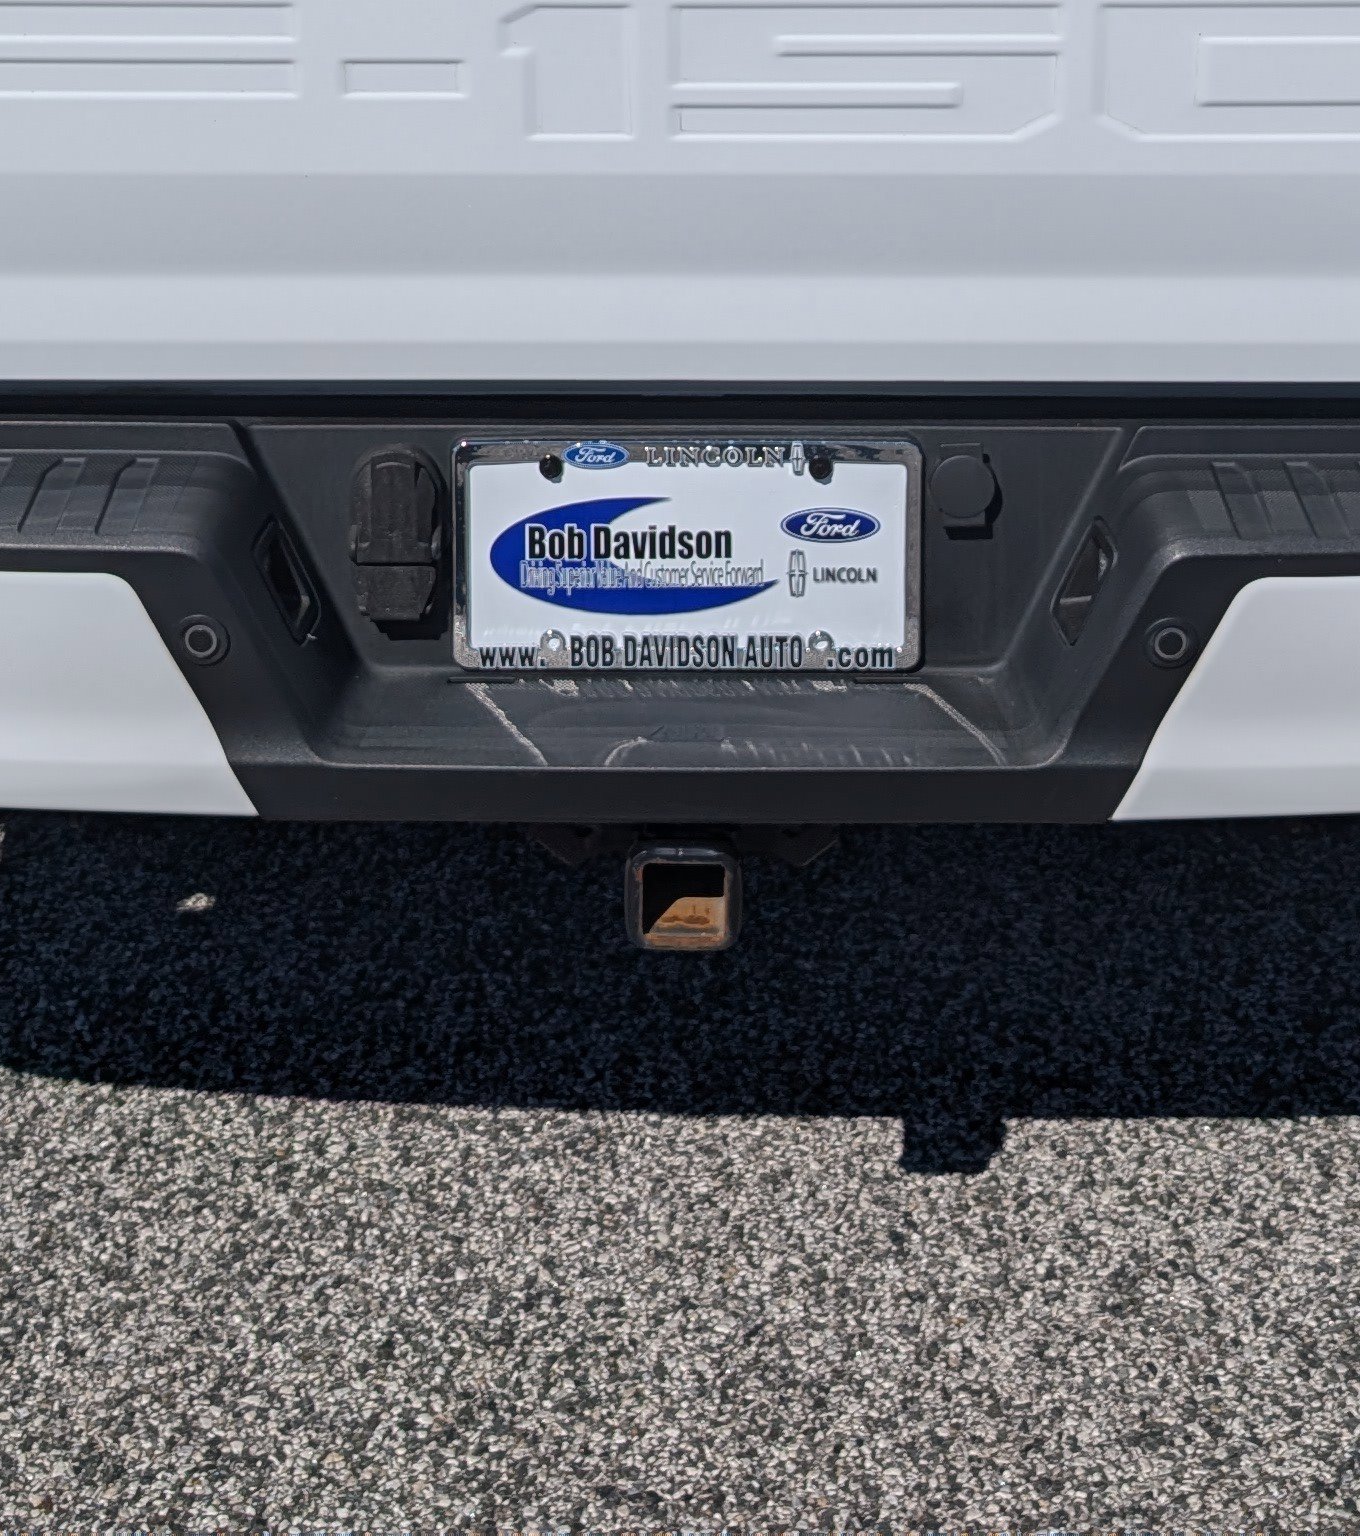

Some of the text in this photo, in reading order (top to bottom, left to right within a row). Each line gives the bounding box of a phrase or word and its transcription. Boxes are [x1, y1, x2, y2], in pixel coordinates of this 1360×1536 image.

[574, 446, 786, 468] Ford LINCOLN
[798, 511, 860, 538] Ford
[528, 525, 732, 560] Bob Davidson
[520, 559, 555, 595] Driving
[555, 559, 596, 595] Superior
[644, 560, 690, 588] Customer
[691, 560, 725, 588] Service
[725, 558, 765, 588] Forward
[812, 566, 878, 583] LINCOLN
[570, 633, 614, 668] BOB
[624, 633, 738, 668] DAVIDSON
[744, 633, 804, 668] AUTO
[826, 646, 894, 669] .com
